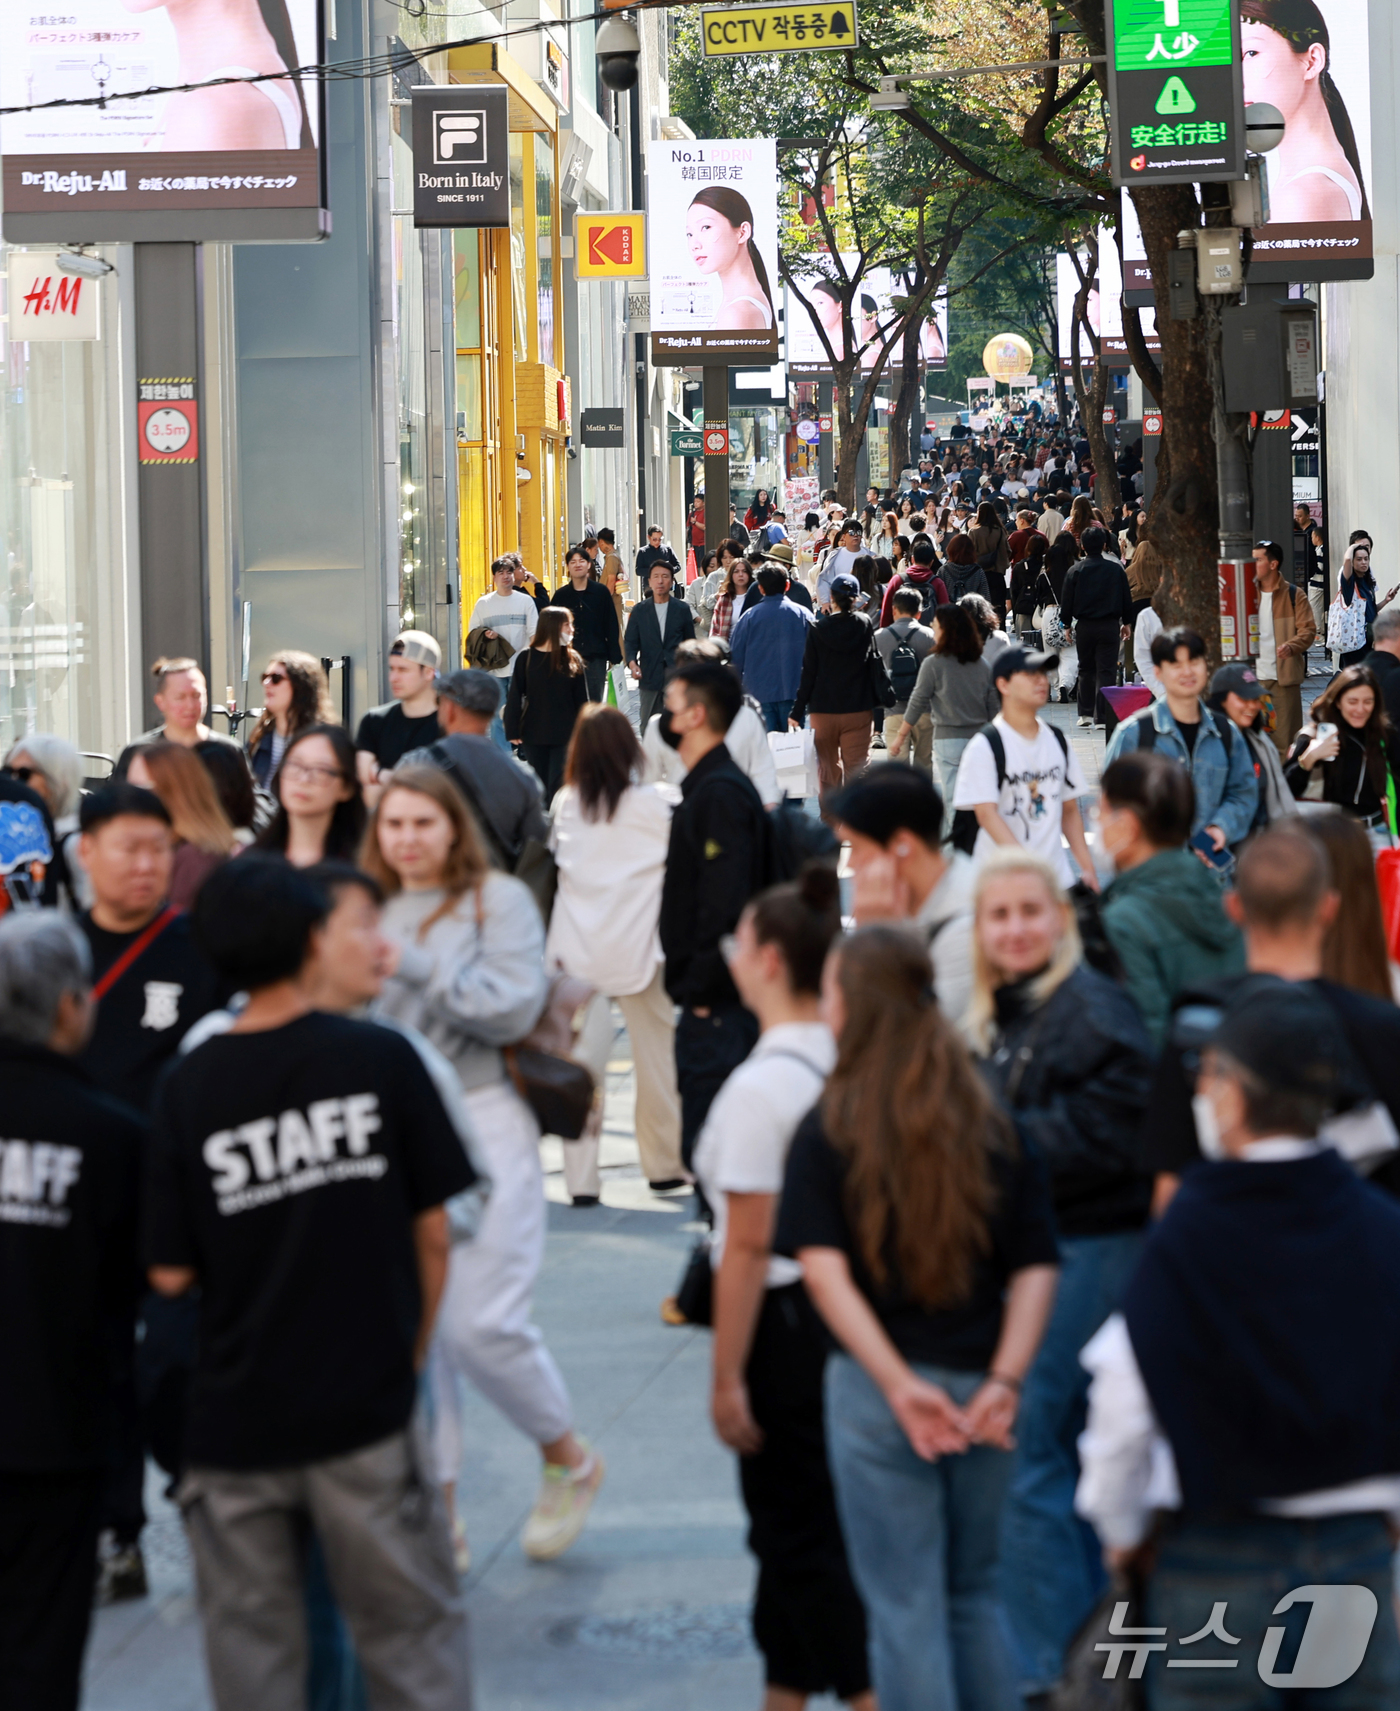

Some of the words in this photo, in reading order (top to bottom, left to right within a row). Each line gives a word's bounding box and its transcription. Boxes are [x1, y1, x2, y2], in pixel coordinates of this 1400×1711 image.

[707, 18, 766, 45] CCTV
[772, 13, 828, 40] 작동중
[1145, 31, 1200, 62] 人少
[1130, 120, 1228, 149] 安全行走!
[671, 149, 706, 163] No.1
[711, 149, 753, 162] PDRN
[21, 170, 127, 196] Dr.Reju-All
[138, 175, 298, 191] お近くの薬局で今すぐチェック
[418, 173, 453, 188] Born
[455, 172, 469, 188] in
[471, 171, 504, 191] Italy
[681, 166, 744, 181] 韓国限定
[437, 195, 464, 203] SINCE
[465, 194, 485, 202] 1911
[622, 228, 630, 262] KODAK
[22, 276, 83, 317] H&M
[658, 337, 702, 348] Dr.Reju-All
[139, 384, 194, 400] 제한높이
[151, 424, 187, 436] 3.5m
[585, 423, 606, 432] Matin
[608, 423, 622, 431] Kim
[202, 1092, 383, 1197] STAFF
